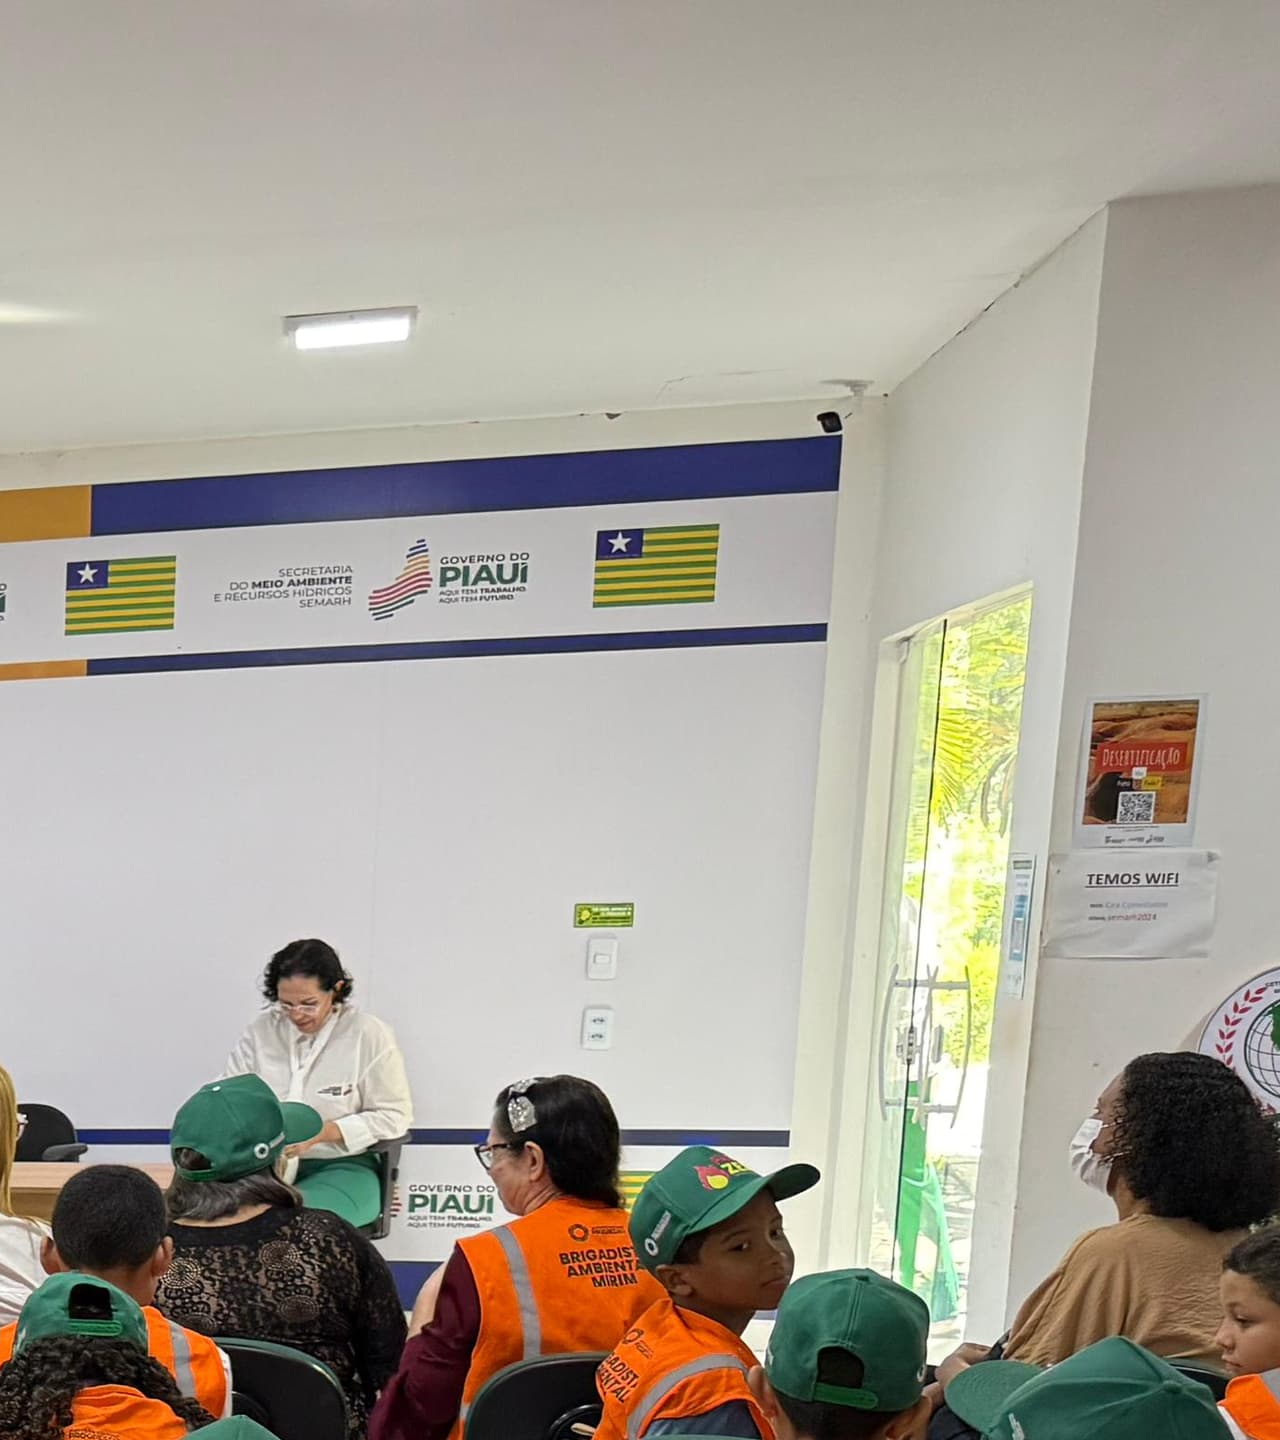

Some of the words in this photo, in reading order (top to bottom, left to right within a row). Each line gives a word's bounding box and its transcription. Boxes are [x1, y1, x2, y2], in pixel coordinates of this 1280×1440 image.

[440, 553, 506, 565] GOVERNO
[509, 552, 529, 561] DO
[278, 565, 353, 577] SECRETARIA
[440, 562, 528, 588] PIAUÍ
[229, 582, 248, 591] DO
[251, 578, 284, 590] MEIO
[287, 575, 352, 588] AMBIENTE
[214, 593, 222, 602] E
[224, 589, 290, 602] RECURSOS
[293, 585, 352, 598] HÍDRICOS
[299, 597, 352, 608] SEMARH
[1087, 873, 1140, 885] TEMOS
[1145, 872, 1179, 884] WIFI
[409, 1184, 473, 1193] GOVERNO
[408, 1193, 494, 1214] PIAUÍ
[559, 1246, 635, 1265] BRIGADIS
[567, 1259, 638, 1277] AMBIENT
[592, 1273, 638, 1288] MIRIM
